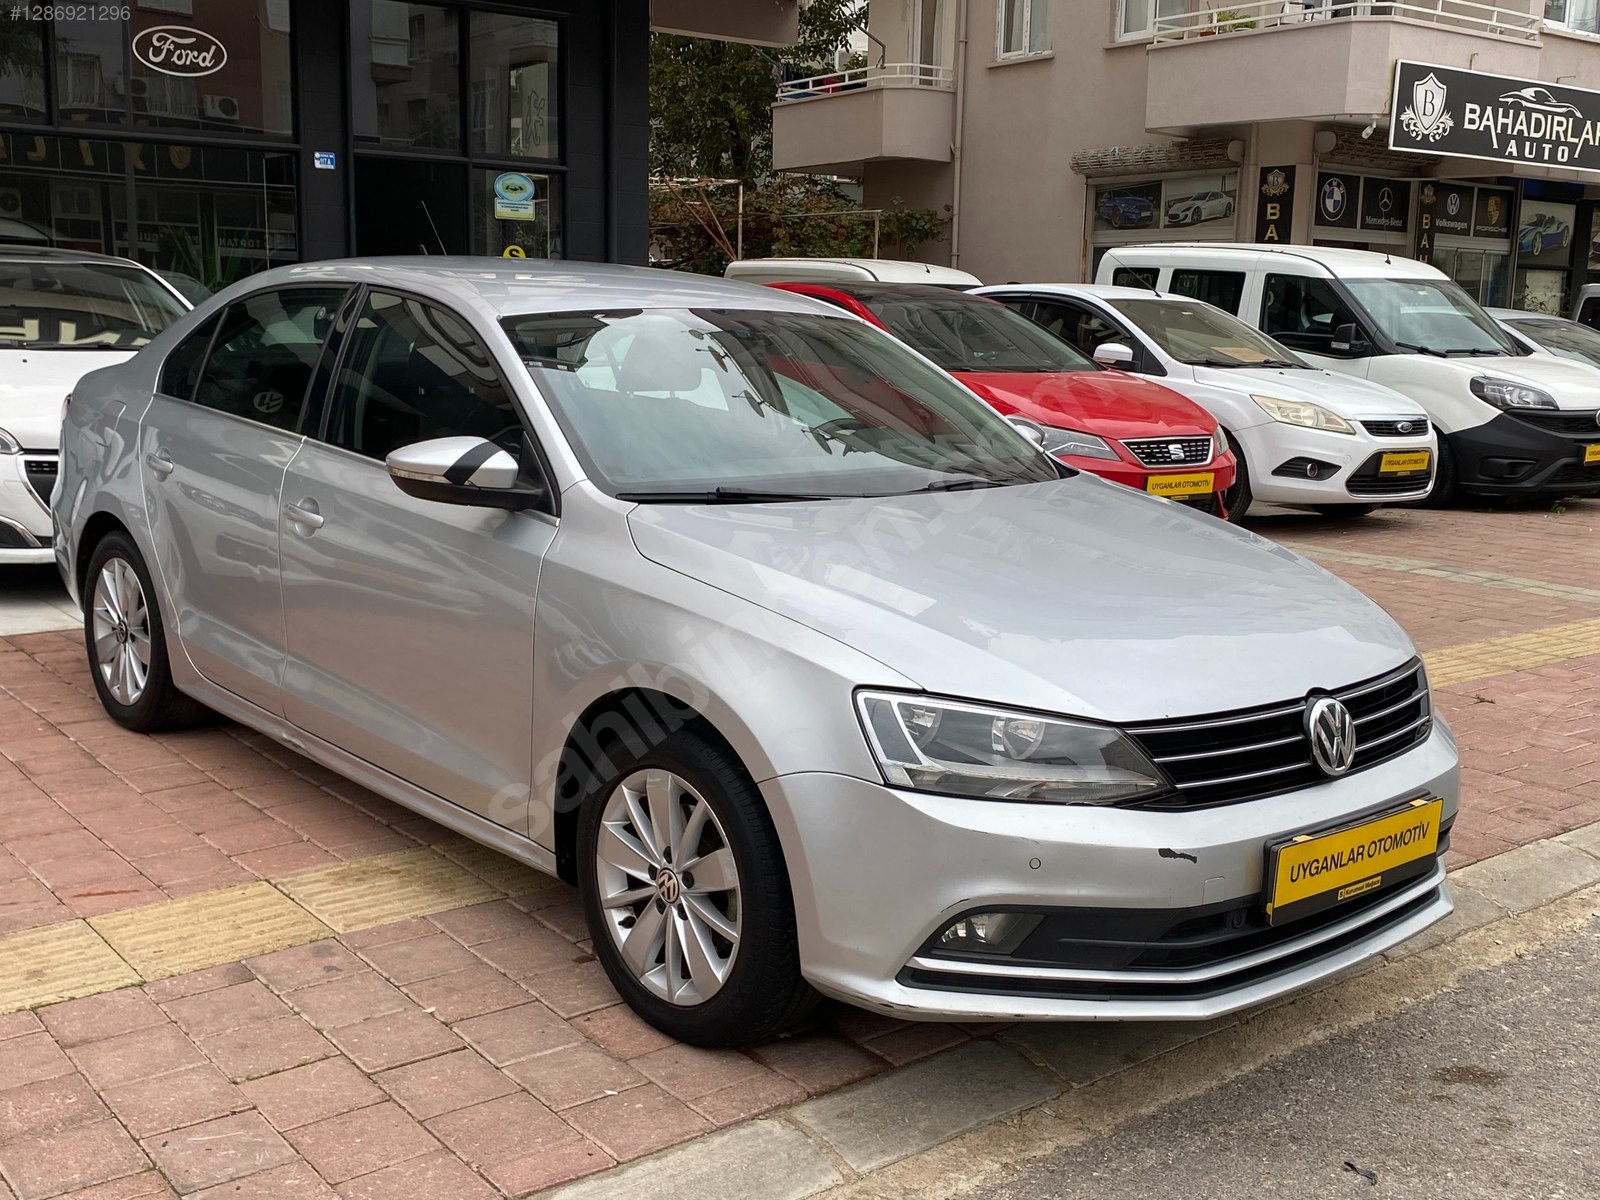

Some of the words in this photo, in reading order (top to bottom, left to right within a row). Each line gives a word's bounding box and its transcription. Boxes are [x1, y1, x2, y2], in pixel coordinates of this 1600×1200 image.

[148, 32, 217, 67] Ford
[1504, 139, 1570, 163] AUTO
[1435, 218, 1468, 231] Volkswagen
[1476, 225, 1508, 233] PORSCHE
[1152, 481, 1181, 490] UYGANLAR
[1289, 844, 1365, 883] UYGANLAR
[1367, 820, 1430, 859] OTOMOTİV
